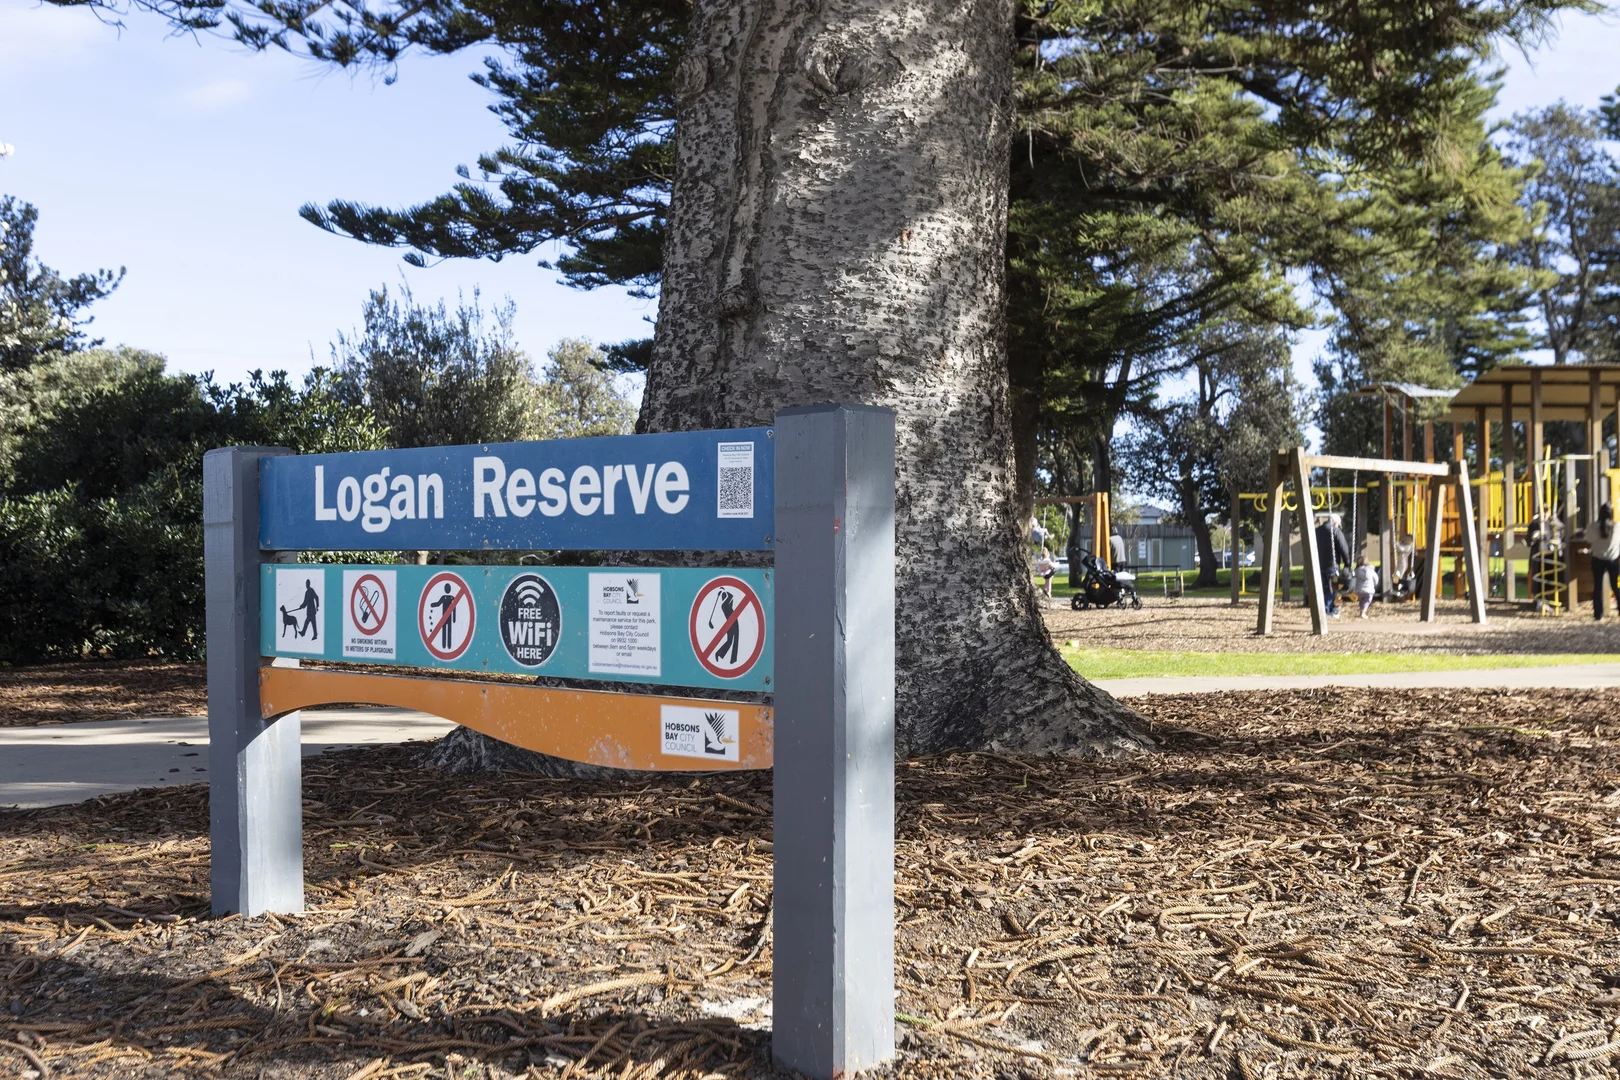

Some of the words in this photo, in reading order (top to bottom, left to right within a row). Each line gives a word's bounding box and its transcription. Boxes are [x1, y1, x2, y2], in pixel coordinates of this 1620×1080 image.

[315, 465, 444, 533] Logan
[473, 456, 690, 517] Reserve
[518, 607, 542, 620] FREE
[508, 621, 552, 646] WiFi
[370, 646, 394, 654] PLAYGROUND
[517, 647, 542, 660] HERE
[665, 722, 700, 733] HOBSONS
[665, 732, 678, 740] BAY
[680, 733, 695, 742] CITY
[665, 741, 697, 753] COUNCIL
